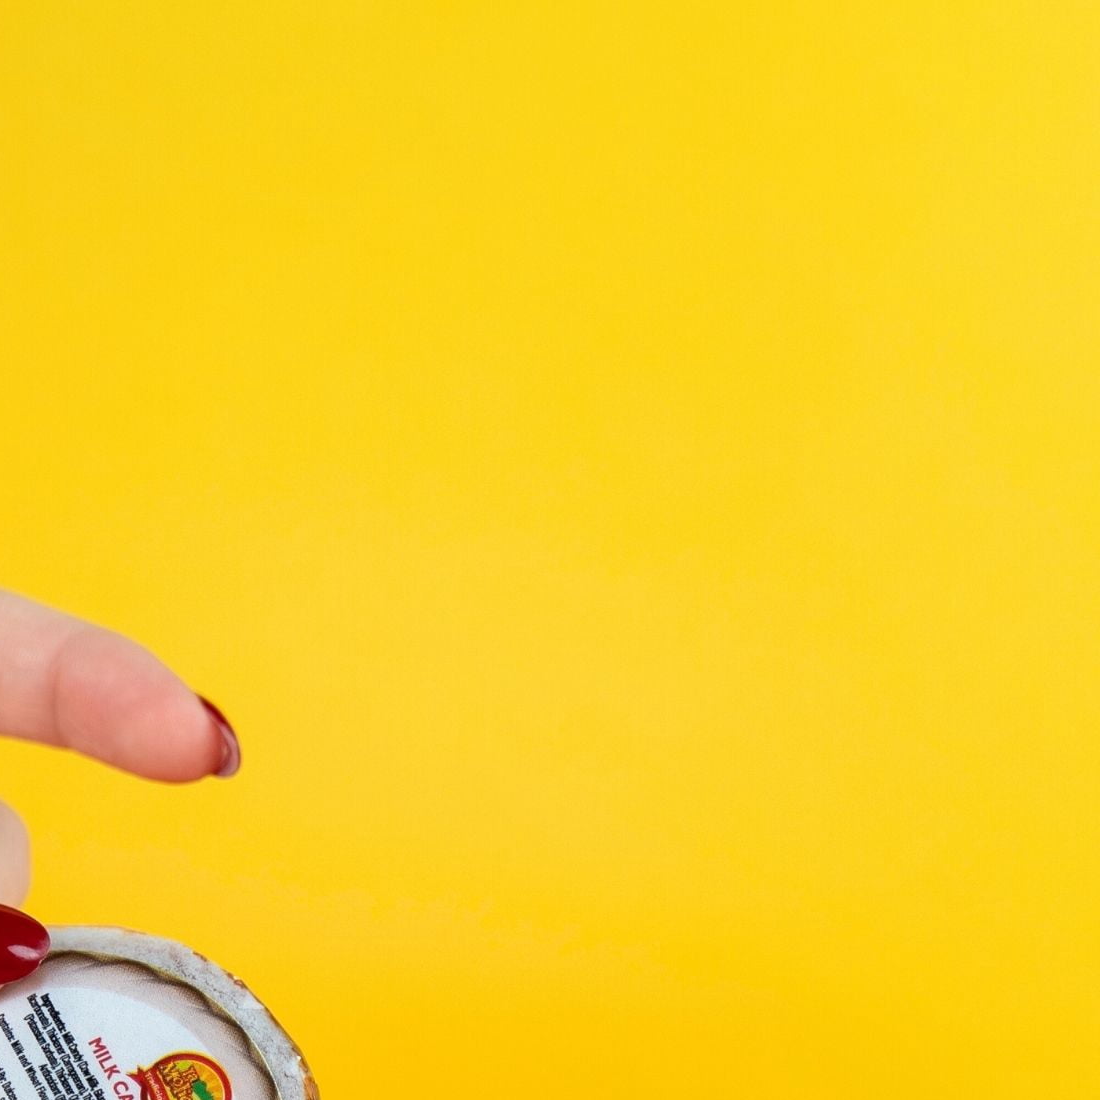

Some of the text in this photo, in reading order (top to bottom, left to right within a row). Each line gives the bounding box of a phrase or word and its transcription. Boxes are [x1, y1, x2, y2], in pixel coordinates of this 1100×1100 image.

[10, 1039, 24, 1056] Milk
[17, 1054, 32, 1067] and
[88, 1036, 120, 1080] MILK
[24, 1065, 42, 1088] Wheat
